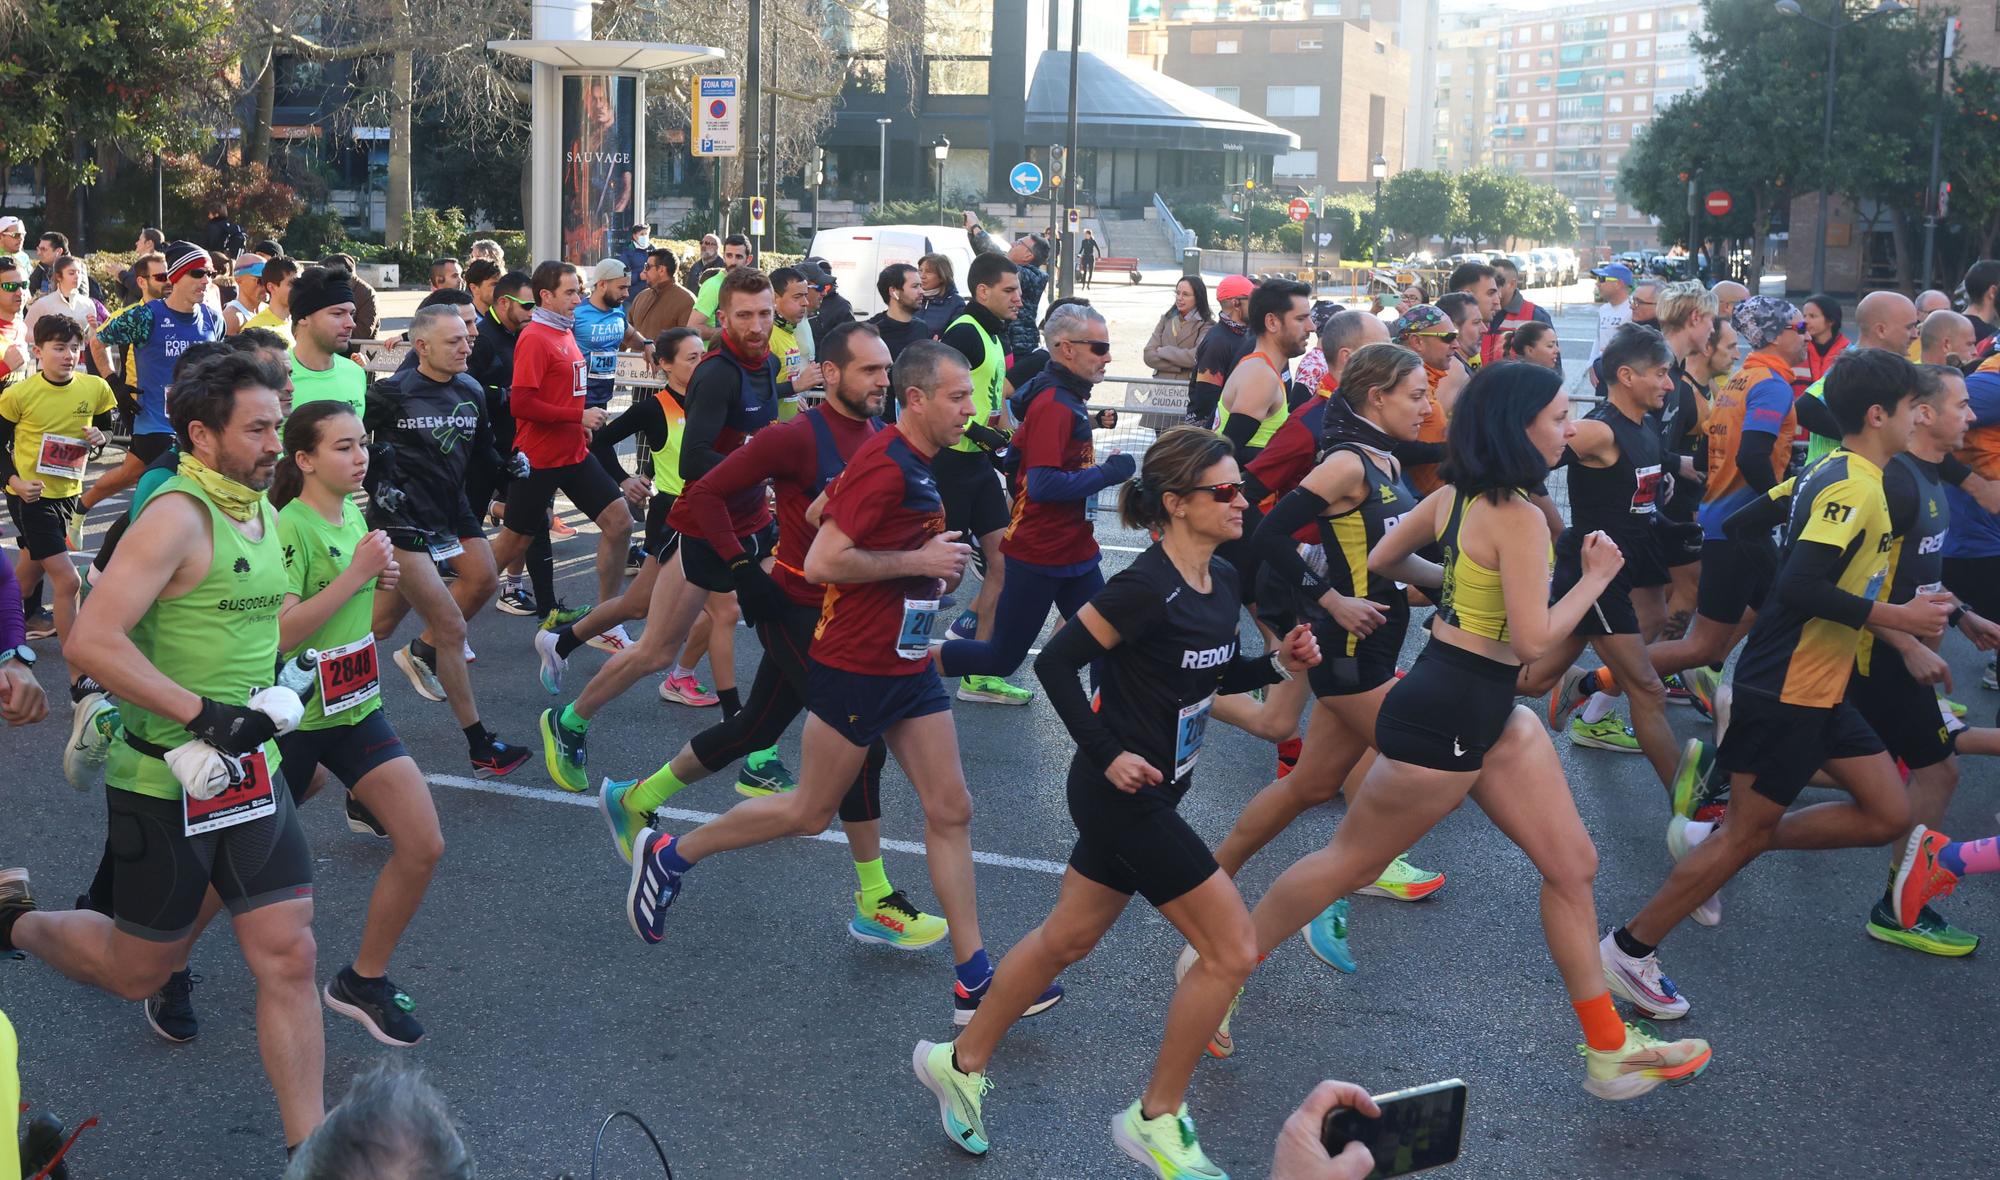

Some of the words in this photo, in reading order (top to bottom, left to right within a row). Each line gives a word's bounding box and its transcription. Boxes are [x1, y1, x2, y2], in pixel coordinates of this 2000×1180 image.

[703, 81, 719, 89] ZONA
[721, 81, 734, 89] ORA
[566, 152, 630, 164] SAUVAGE
[1152, 397, 1182, 407] CIUDAD
[397, 416, 443, 429] GREEN
[329, 649, 371, 687] 2848
[874, 912, 905, 933] HOKA
